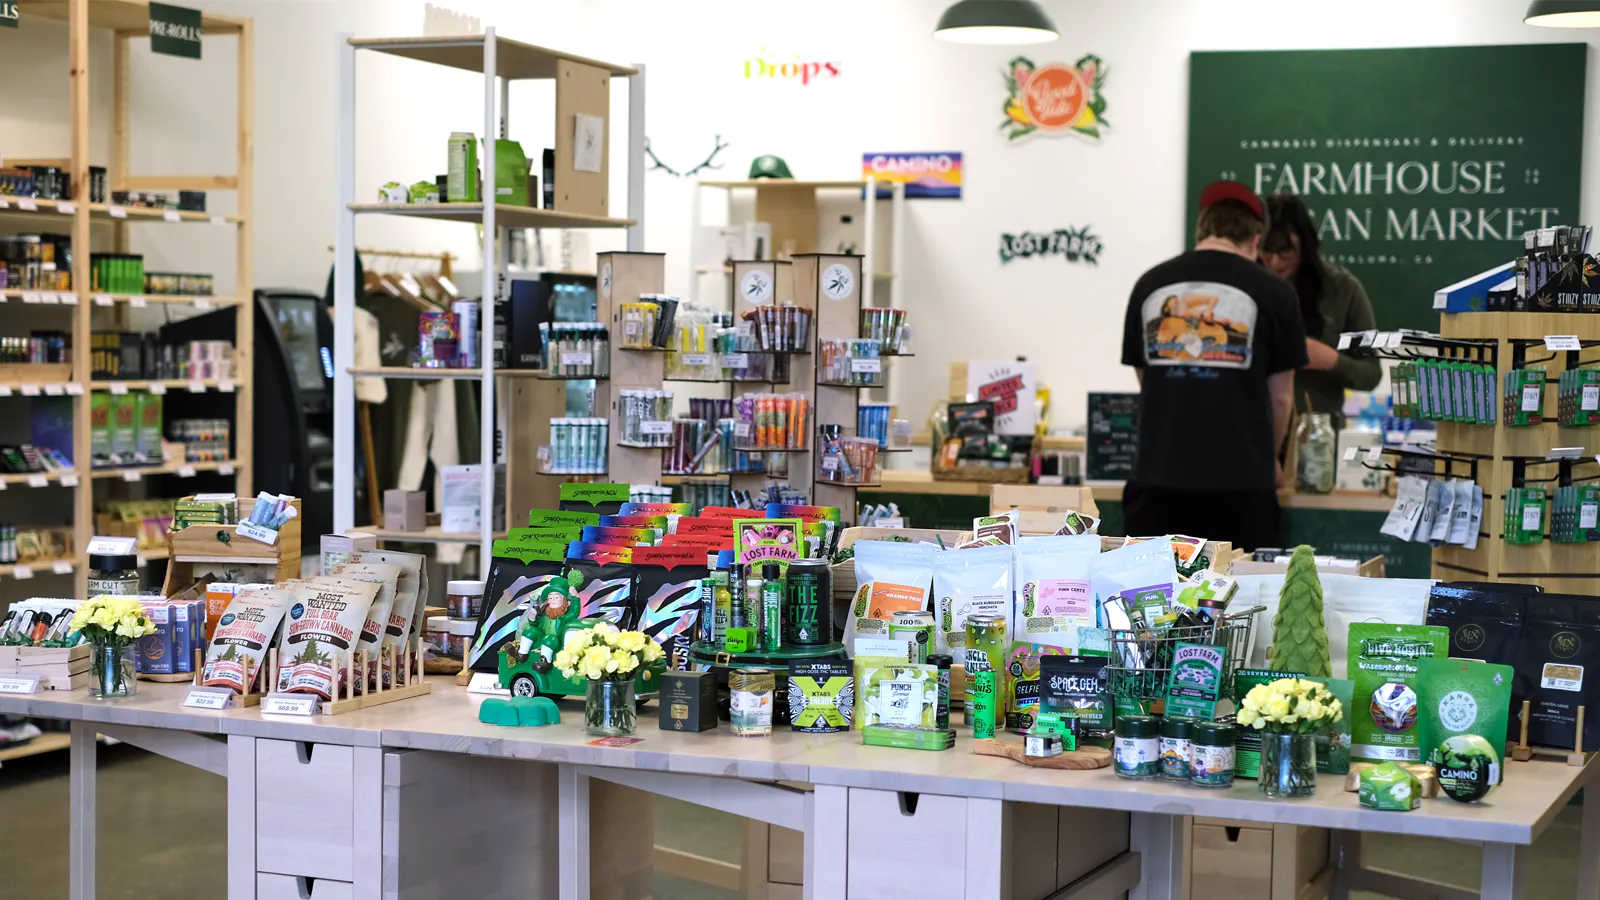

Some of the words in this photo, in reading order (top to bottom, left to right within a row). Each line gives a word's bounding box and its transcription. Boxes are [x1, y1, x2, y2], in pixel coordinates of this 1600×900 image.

[149, 20, 203, 42] PRE-ROLLS
[743, 57, 841, 86] Drops
[1240, 138, 1317, 149] CANNABIS
[1326, 137, 1421, 148] DISPENSARY
[1431, 136, 1439, 147] &
[1448, 136, 1525, 147] DELIVERY
[871, 155, 953, 174] CAMINO
[1254, 160, 1506, 196] FARMHOUSE
[1316, 207, 1372, 241] AN
[1386, 207, 1560, 241] MARKET
[1583, 293, 1600, 306] STIIIZ
[744, 547, 766, 561] LOST
[769, 547, 796, 560] FARM
[102, 581, 120, 590] CUT
[316, 592, 344, 602] MOST
[789, 585, 818, 604] THE
[886, 592, 909, 600] ORANGE
[307, 598, 347, 612] WANTED
[305, 608, 320, 619] FULL
[321, 609, 339, 621] BOAR
[789, 604, 818, 623] FIZZ
[300, 633, 332, 643] FLOWER
[320, 620, 354, 642] CANNABIS
[224, 639, 249, 647] FLOWER
[1178, 648, 1198, 659] LOST
[1199, 648, 1220, 664] FARM
[890, 683, 912, 691] PUNCH
[1016, 683, 1040, 694] SELFIE
[1050, 675, 1080, 693] SPACE
[1080, 676, 1104, 694] GEM
[809, 696, 833, 705] ENERGY
[1443, 692, 1475, 709] KANHA
[1440, 768, 1478, 781] CAMINO
